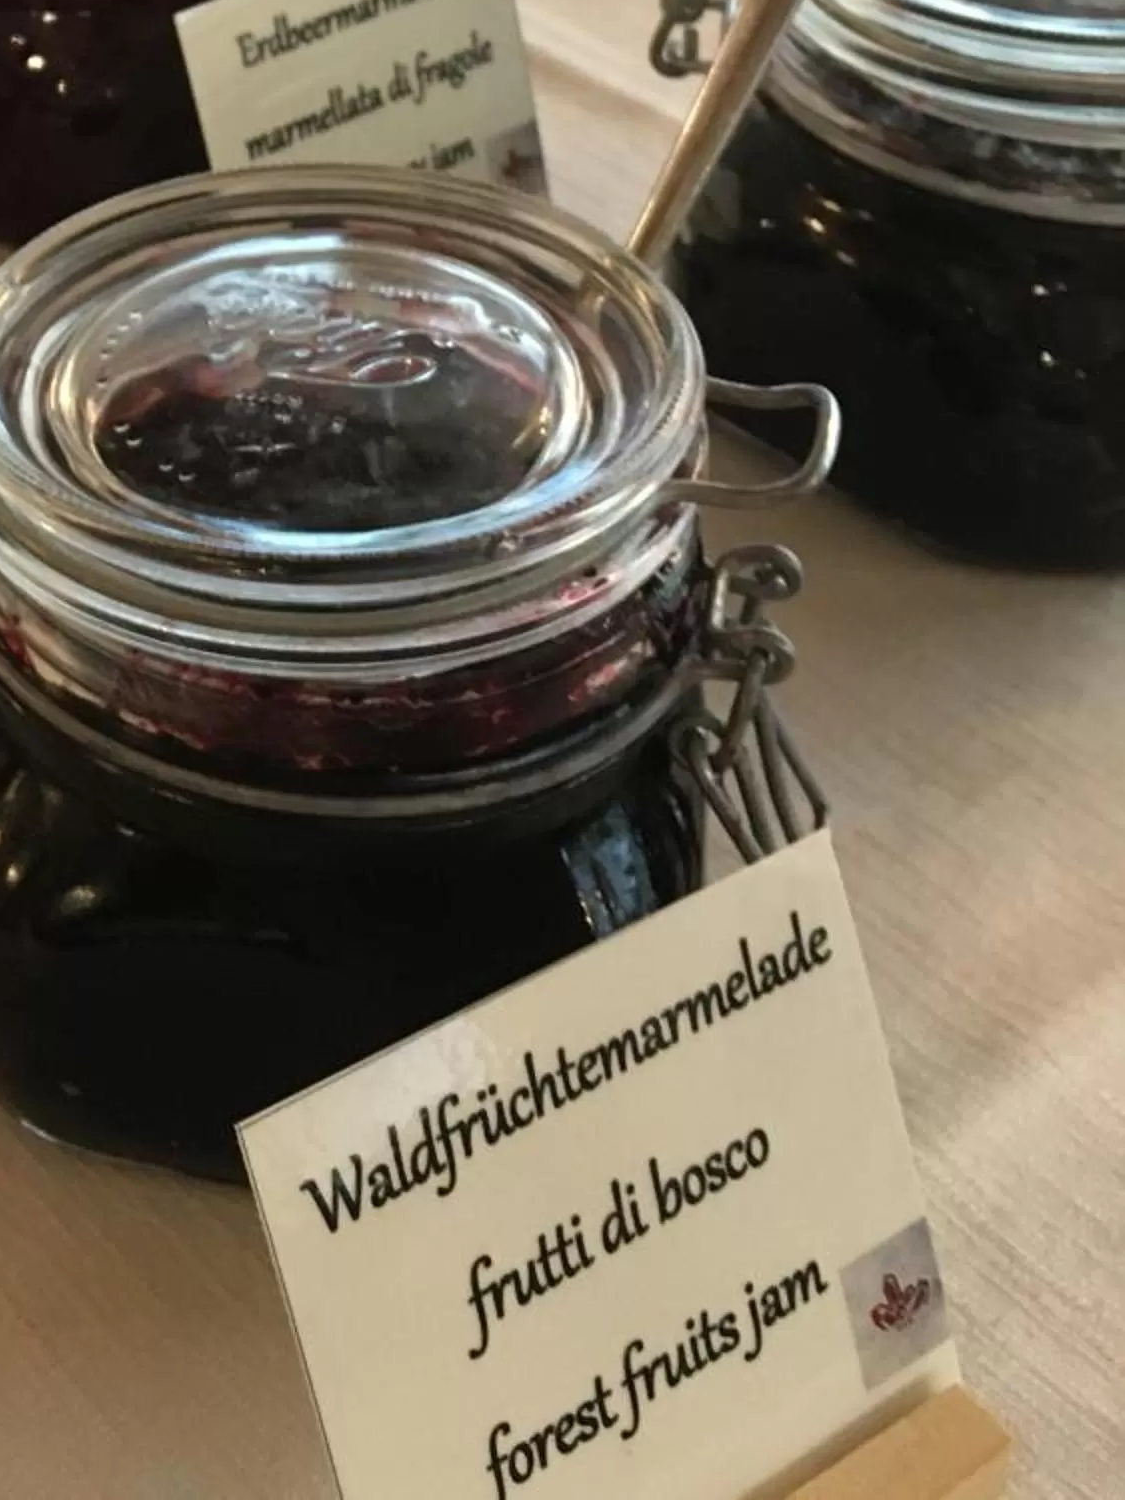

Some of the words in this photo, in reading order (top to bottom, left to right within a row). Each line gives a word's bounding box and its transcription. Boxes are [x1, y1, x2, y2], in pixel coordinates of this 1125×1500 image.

[245, 85, 385, 161] marmellata
[387, 61, 413, 102] di
[411, 31, 494, 105] fragole
[300, 911, 833, 1234] Waldfrüchtemarmelade
[467, 1215, 596, 1359] frutti
[601, 1180, 650, 1256] di
[650, 1127, 771, 1226] bosco
[485, 1376, 620, 1500] forest
[620, 1317, 742, 1440] fruits
[744, 1259, 829, 1362] jam
